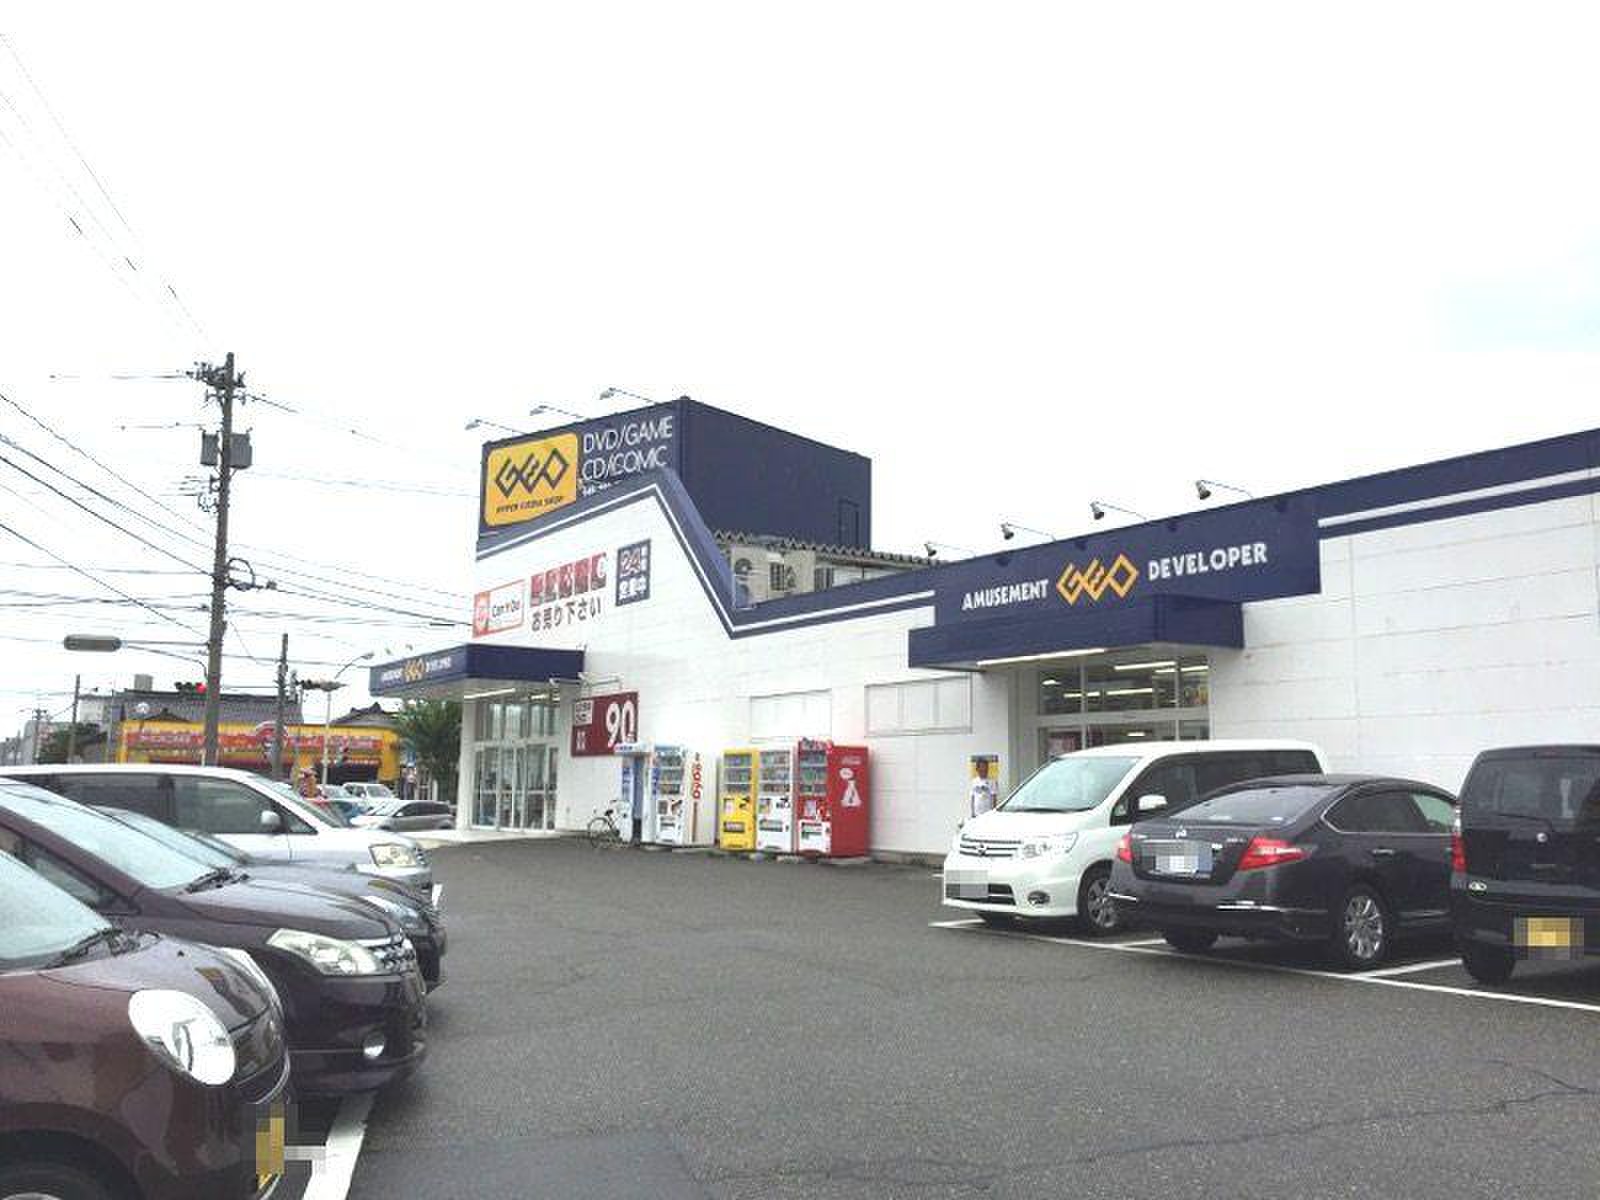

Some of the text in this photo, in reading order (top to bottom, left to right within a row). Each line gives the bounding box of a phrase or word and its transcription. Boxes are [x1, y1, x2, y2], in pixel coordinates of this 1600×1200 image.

[494, 448, 569, 498] GEO
[961, 543, 1268, 611] AMUSEMENT GEO DEVELOPER
